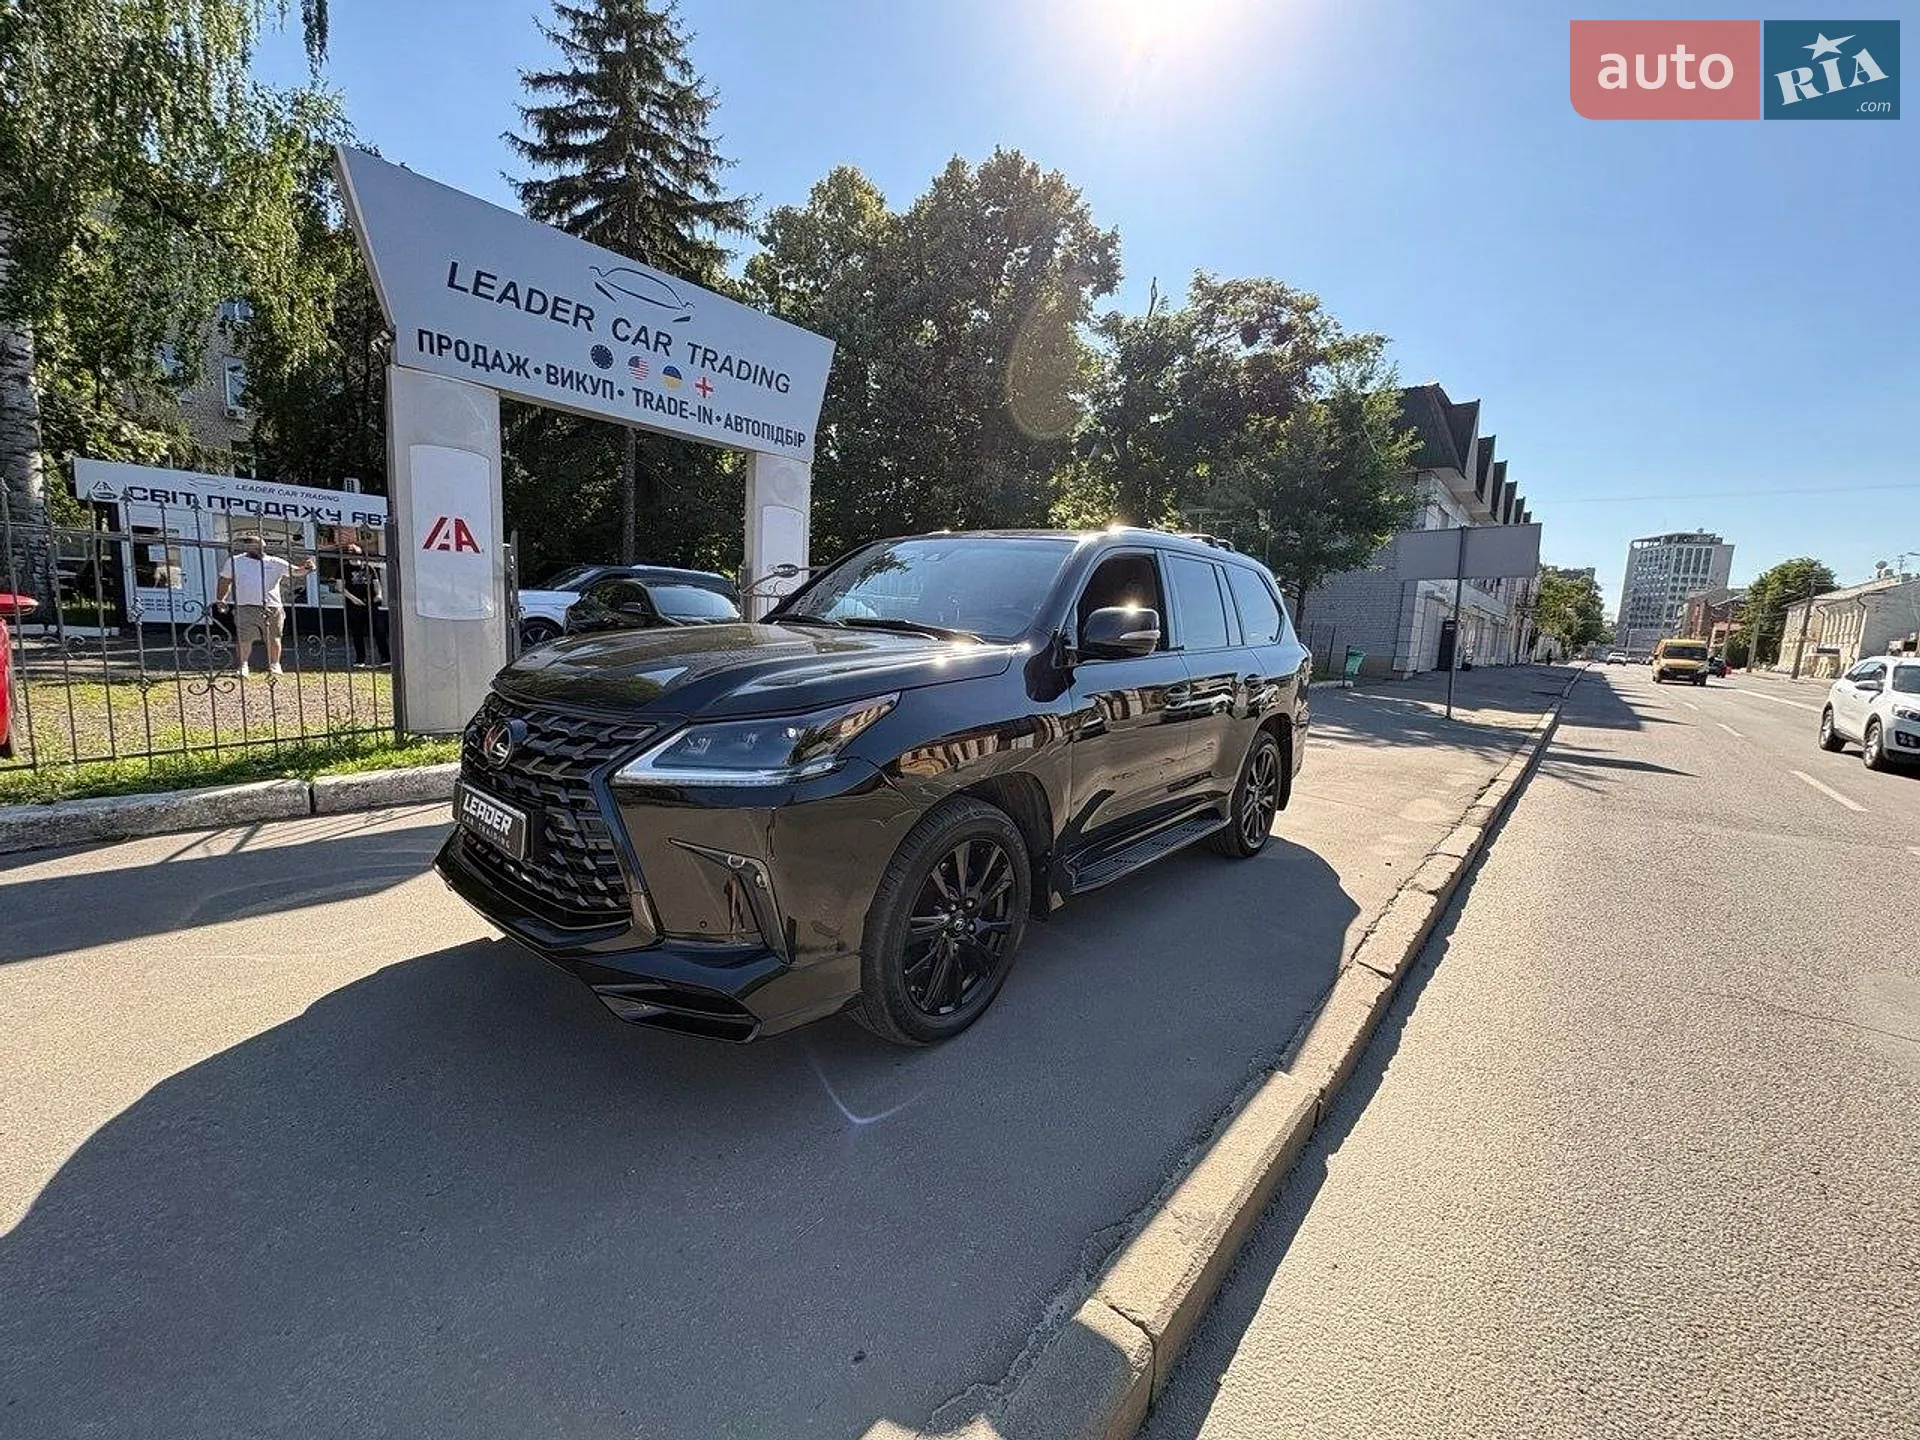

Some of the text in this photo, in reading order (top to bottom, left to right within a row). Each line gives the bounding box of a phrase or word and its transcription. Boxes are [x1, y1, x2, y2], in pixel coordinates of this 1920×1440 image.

[447, 261, 791, 394] LEADER CAR TRADING
[417, 328, 806, 448] ПРОДАЖ ВИКУП TRADE-IN АВТОПІДБІР
[128, 486, 197, 506] СВІТ
[207, 495, 342, 522] ПРОДАЖУ
[352, 511, 390, 527] АВ
[235, 483, 340, 503] LEADER CAR TRADING
[463, 793, 513, 836] LEADER
